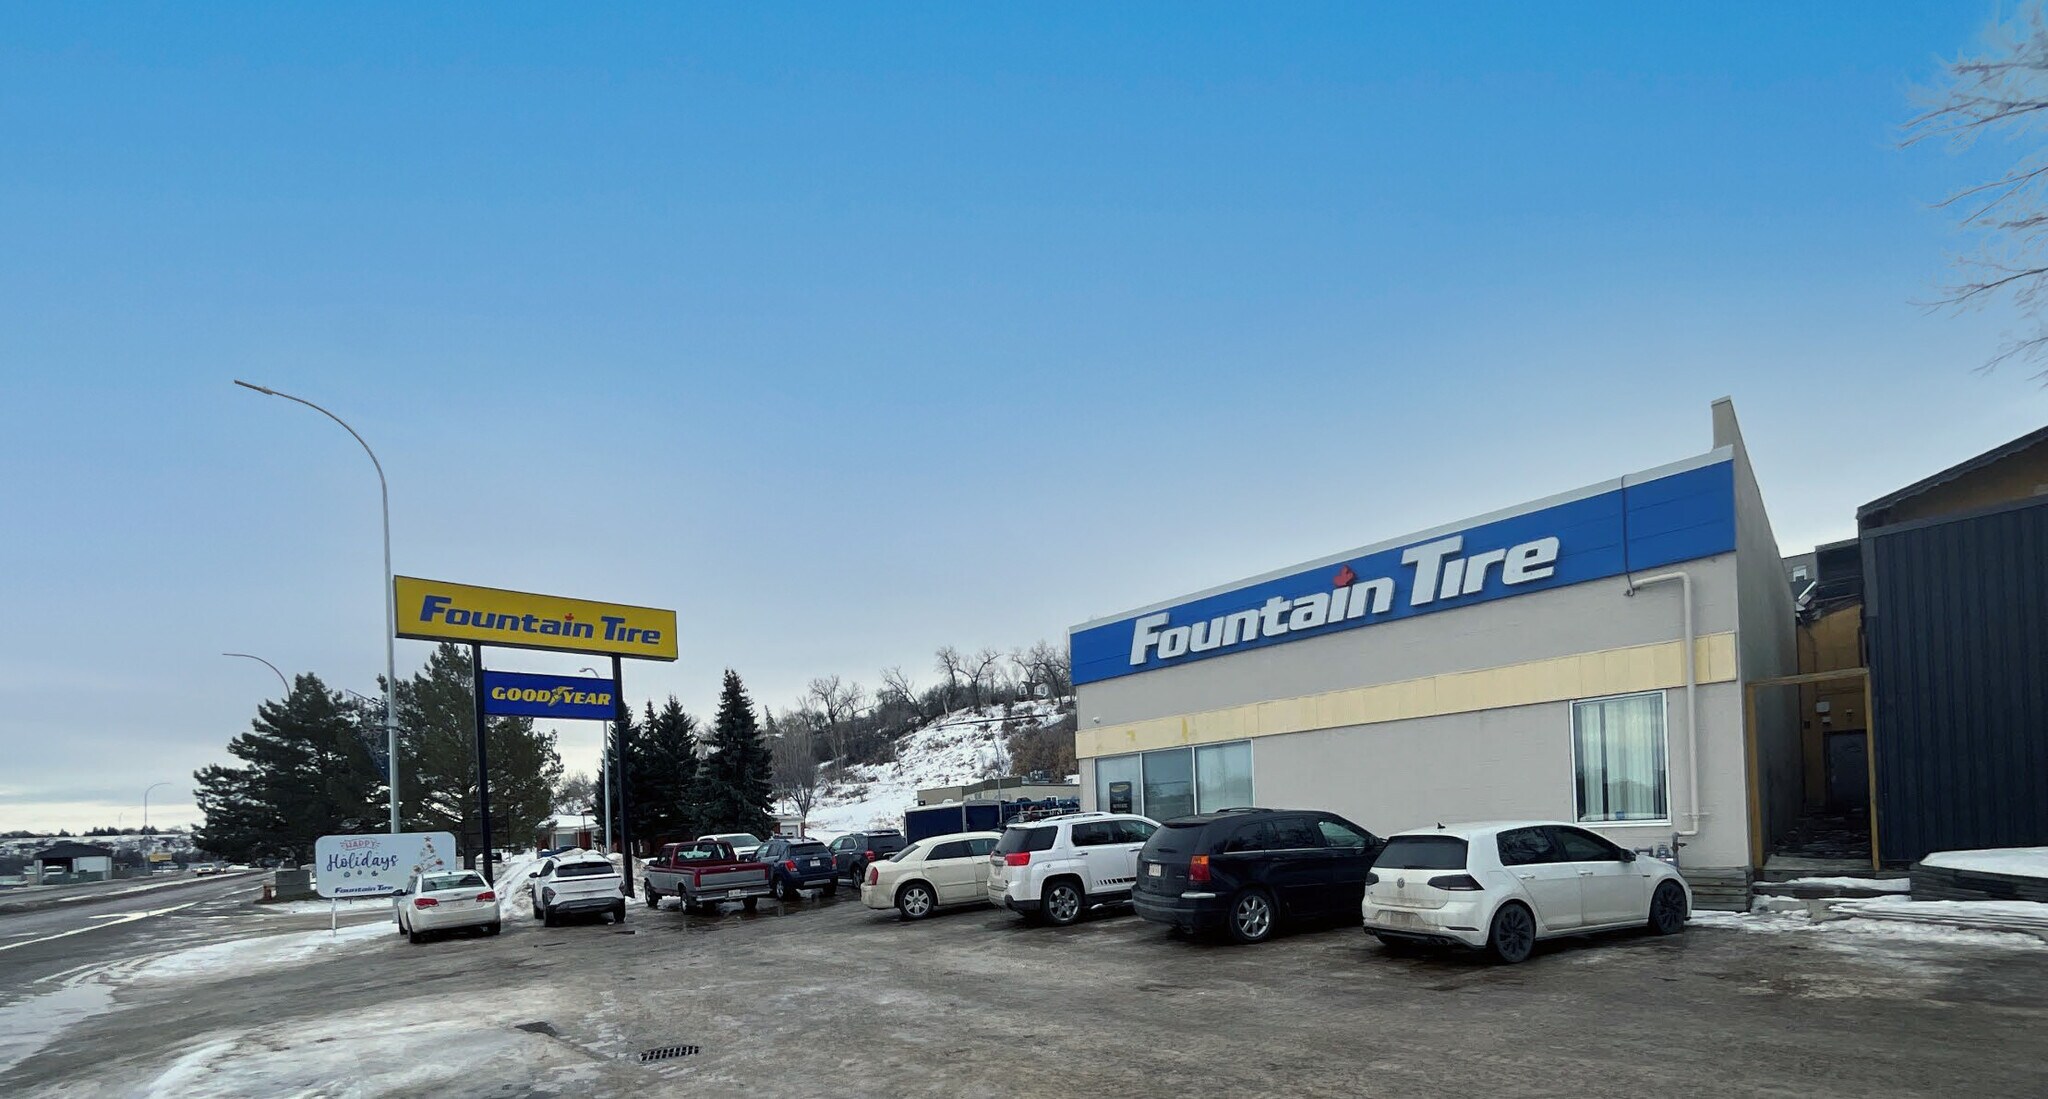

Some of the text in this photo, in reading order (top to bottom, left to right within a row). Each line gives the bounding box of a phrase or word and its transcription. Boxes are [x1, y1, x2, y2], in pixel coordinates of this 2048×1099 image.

[1129, 535, 1561, 666] Fountain Tire
[420, 595, 661, 645] Fountain Tire
[491, 686, 611, 706] GOODYEAR
[345, 840, 376, 849] HAPPY
[327, 850, 398, 871] Holidays
